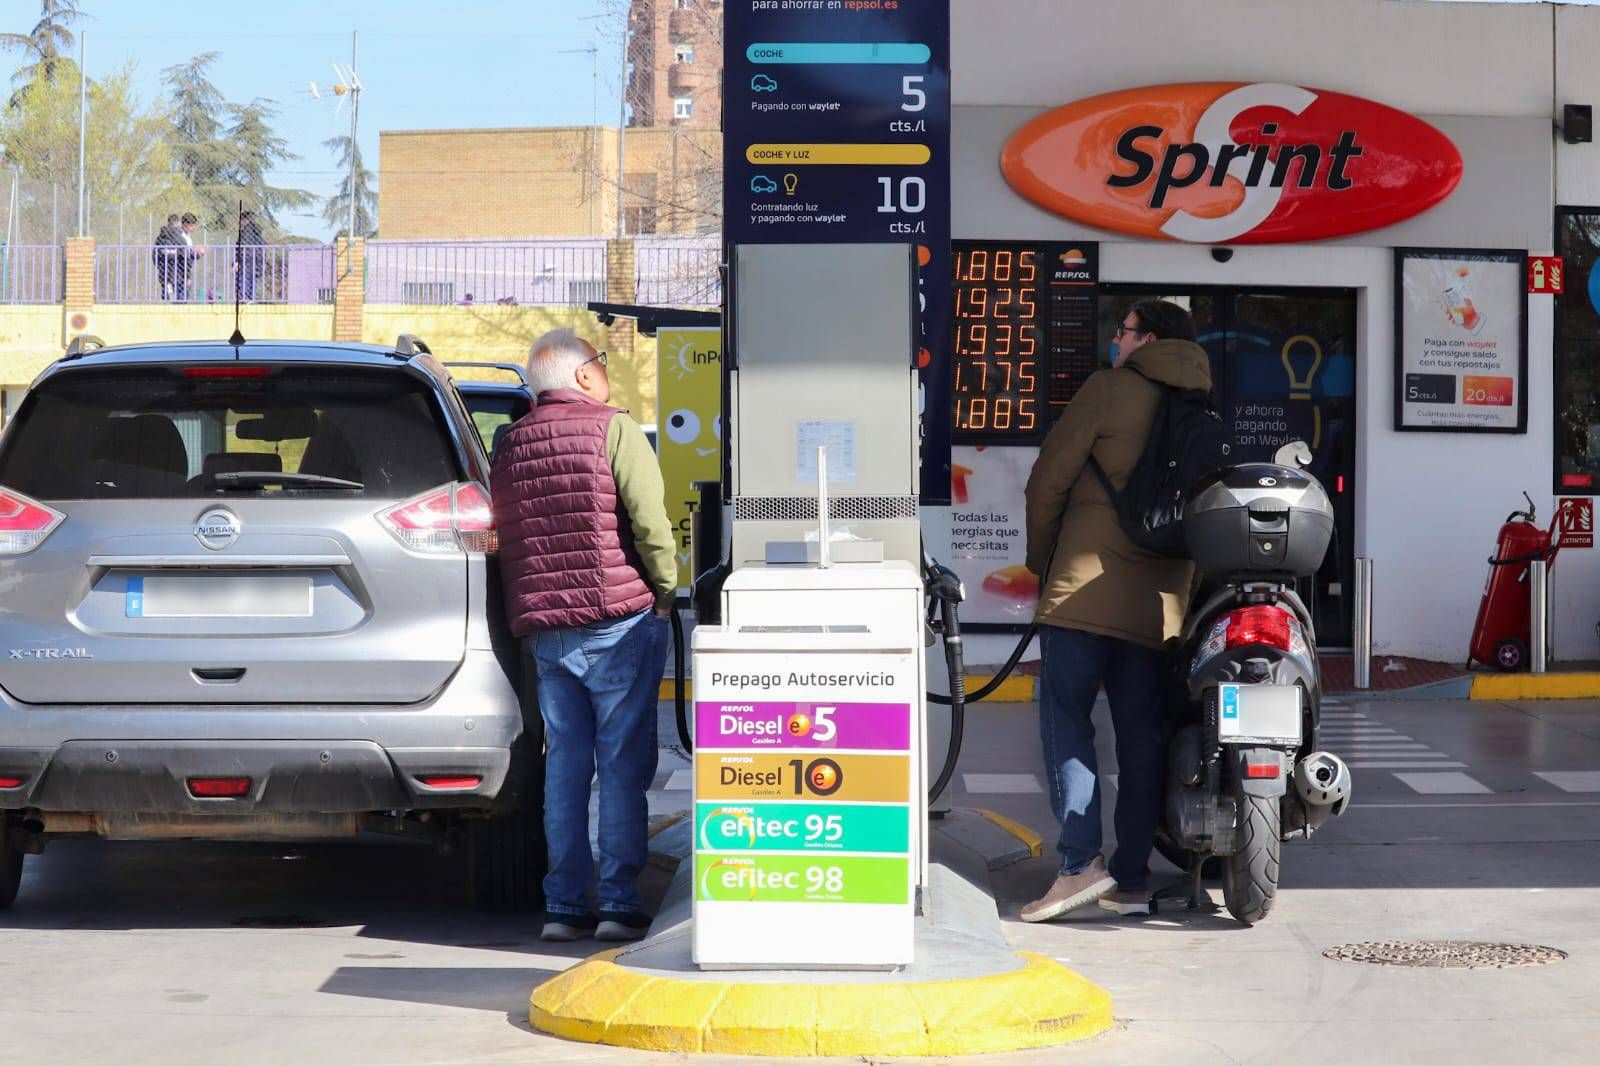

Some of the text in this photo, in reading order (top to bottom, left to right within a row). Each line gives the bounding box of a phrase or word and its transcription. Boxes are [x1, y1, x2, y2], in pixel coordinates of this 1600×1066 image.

[752, 0, 898, 11] para ahorrar en repsol.es
[753, 50, 784, 58] COCHE
[901, 76, 926, 112] 5
[752, 101, 840, 112] Pagando con waylet
[889, 120, 926, 132] cts./l
[753, 150, 810, 159] COCHE Y LUZ
[1106, 123, 1364, 208] Sprint
[877, 176, 926, 213] 10
[751, 202, 818, 211] Contratando luz
[751, 215, 757, 224] y
[758, 214, 795, 224] pagando
[814, 214, 846, 223] waylet
[889, 221, 926, 233] cts./l
[955, 251, 1036, 281] 1.885
[1054, 271, 1090, 279] REPSOL
[955, 288, 1036, 318] 1.925
[955, 325, 1036, 355] 1.935
[1424, 338, 1447, 347] Paga
[1449, 340, 1465, 348] con
[1430, 349, 1470, 358] consigue
[1472, 351, 1497, 359] saldo
[1454, 361, 1501, 370] repostajes
[955, 362, 1036, 392] 1.775
[1409, 386, 1418, 399] 5
[1466, 389, 1486, 401] 20
[955, 399, 1036, 429] 1.885
[1235, 403, 1284, 417] y ahorra
[1235, 420, 1287, 433] pagando
[952, 512, 1008, 522] Todas las
[996, 528, 1019, 538] que
[132, 601, 139, 609] E
[8, 648, 94, 660] X-TRAIL
[712, 673, 895, 689] Prepago Autoservicio
[1226, 705, 1234, 714] E
[720, 715, 783, 735] Diesel
[720, 766, 782, 786] Diesel
[721, 815, 843, 841] efitec 95
[722, 866, 843, 892] efitec 98
